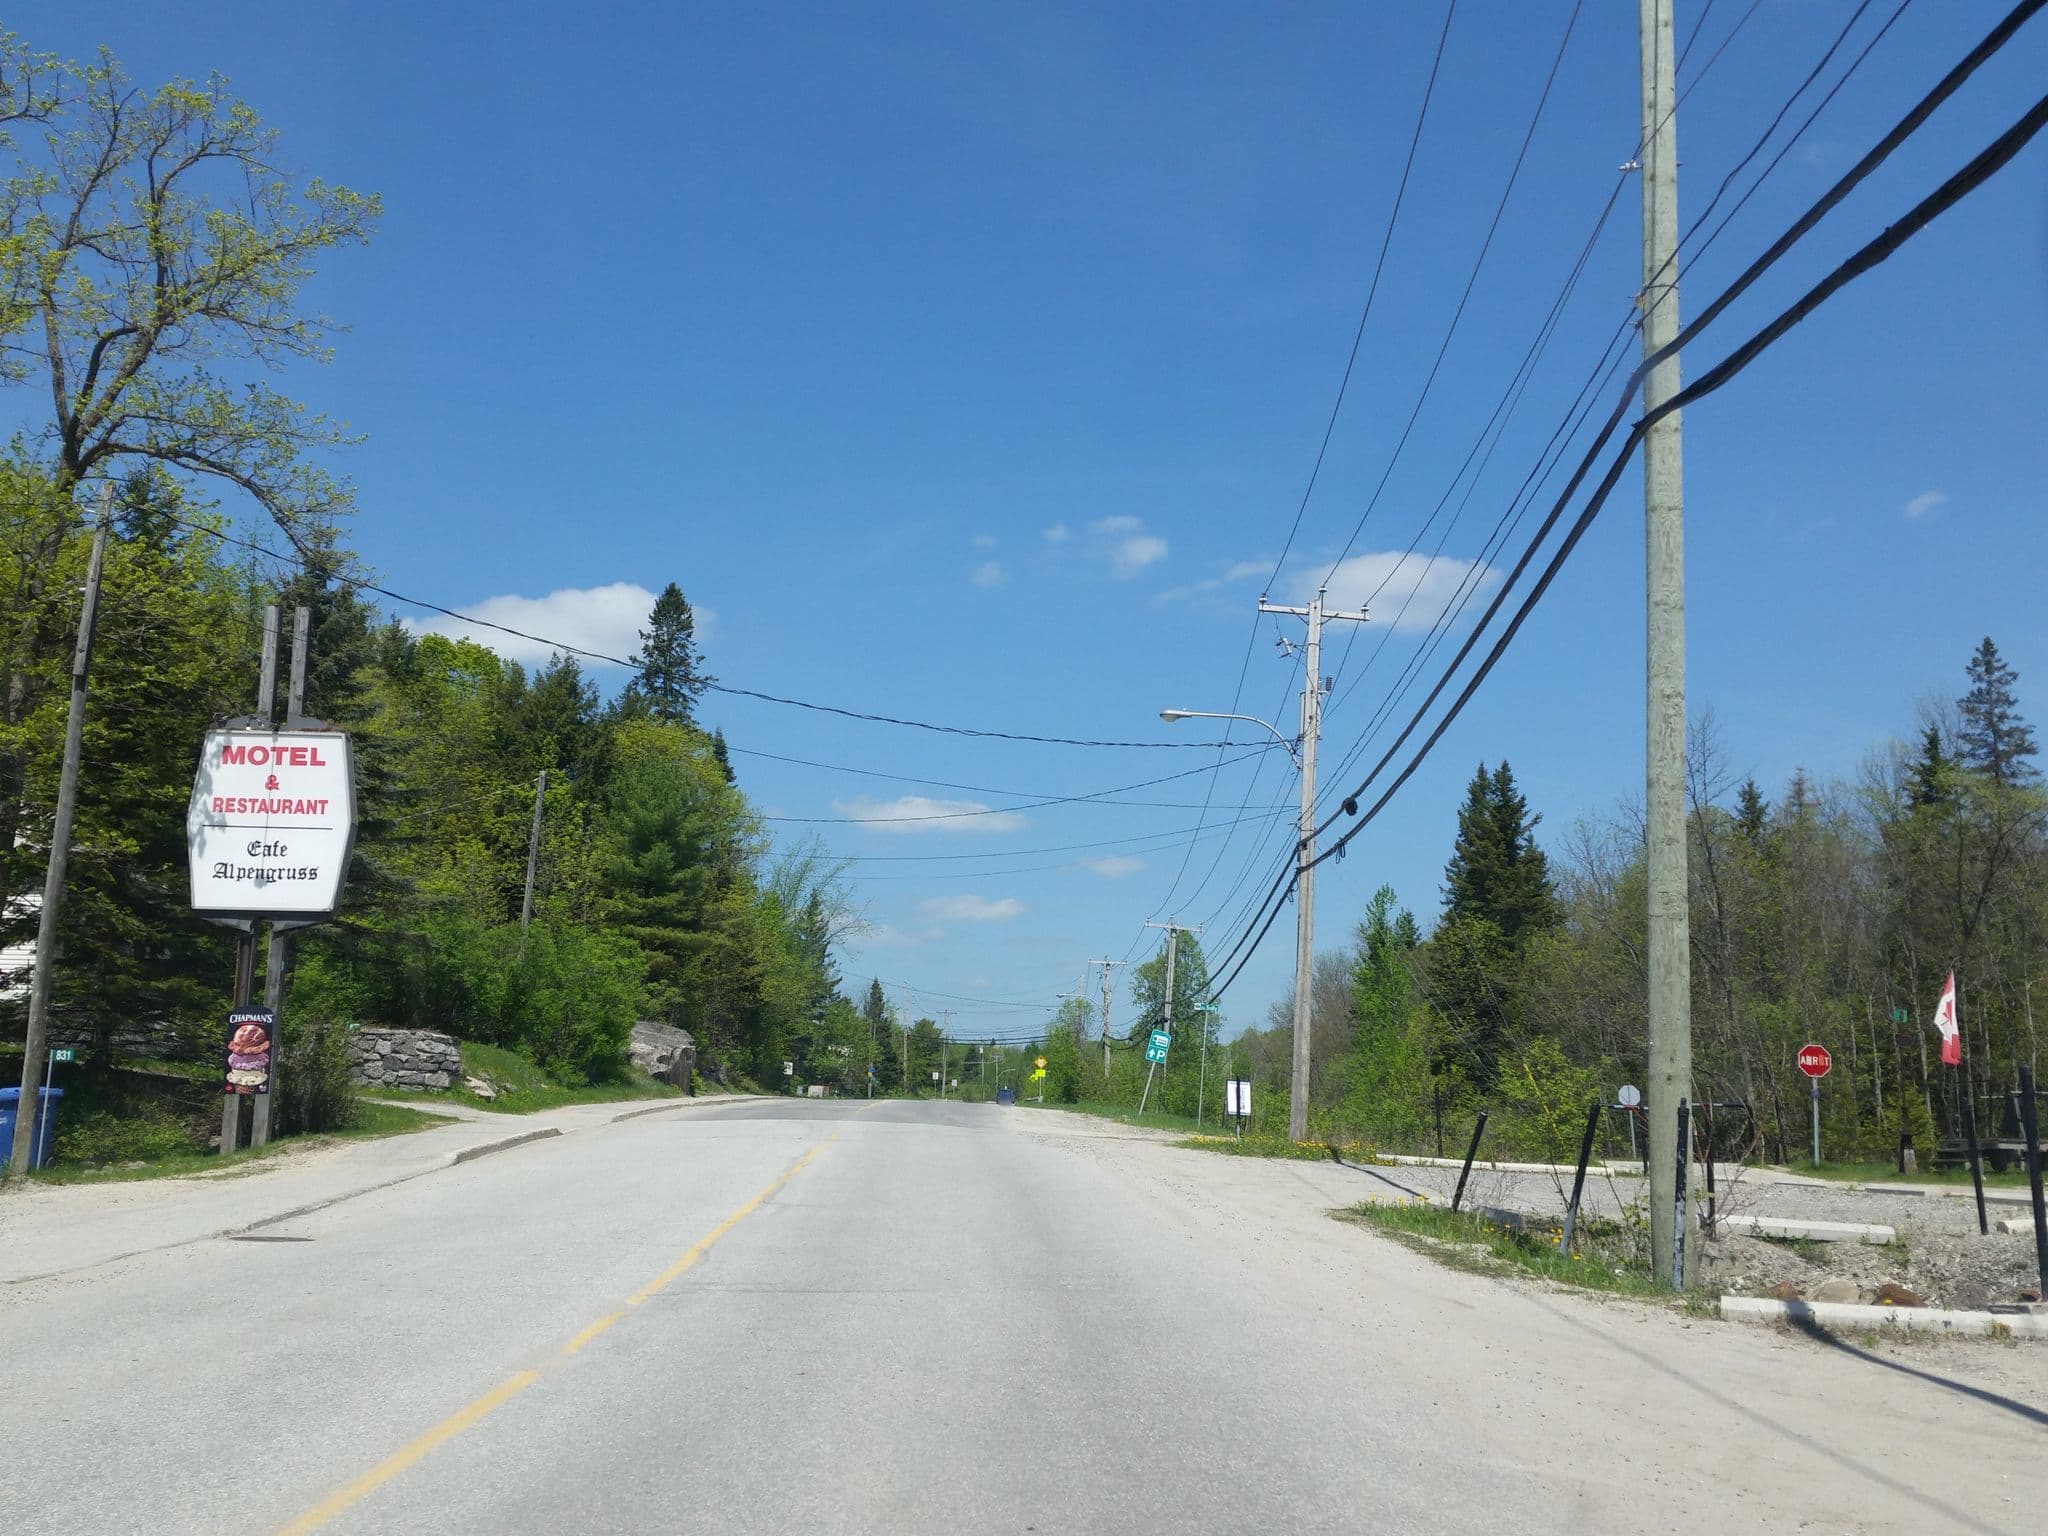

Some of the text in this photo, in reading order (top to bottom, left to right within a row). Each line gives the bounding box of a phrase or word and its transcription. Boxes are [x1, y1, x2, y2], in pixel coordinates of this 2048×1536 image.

[222, 745, 326, 766] MOTEL
[265, 774, 280, 791] &
[212, 797, 329, 815] RESTAURANT
[212, 862, 319, 883] Alpengruss
[229, 1014, 273, 1024] CHAPMAN'S
[56, 1050, 71, 1060] 831
